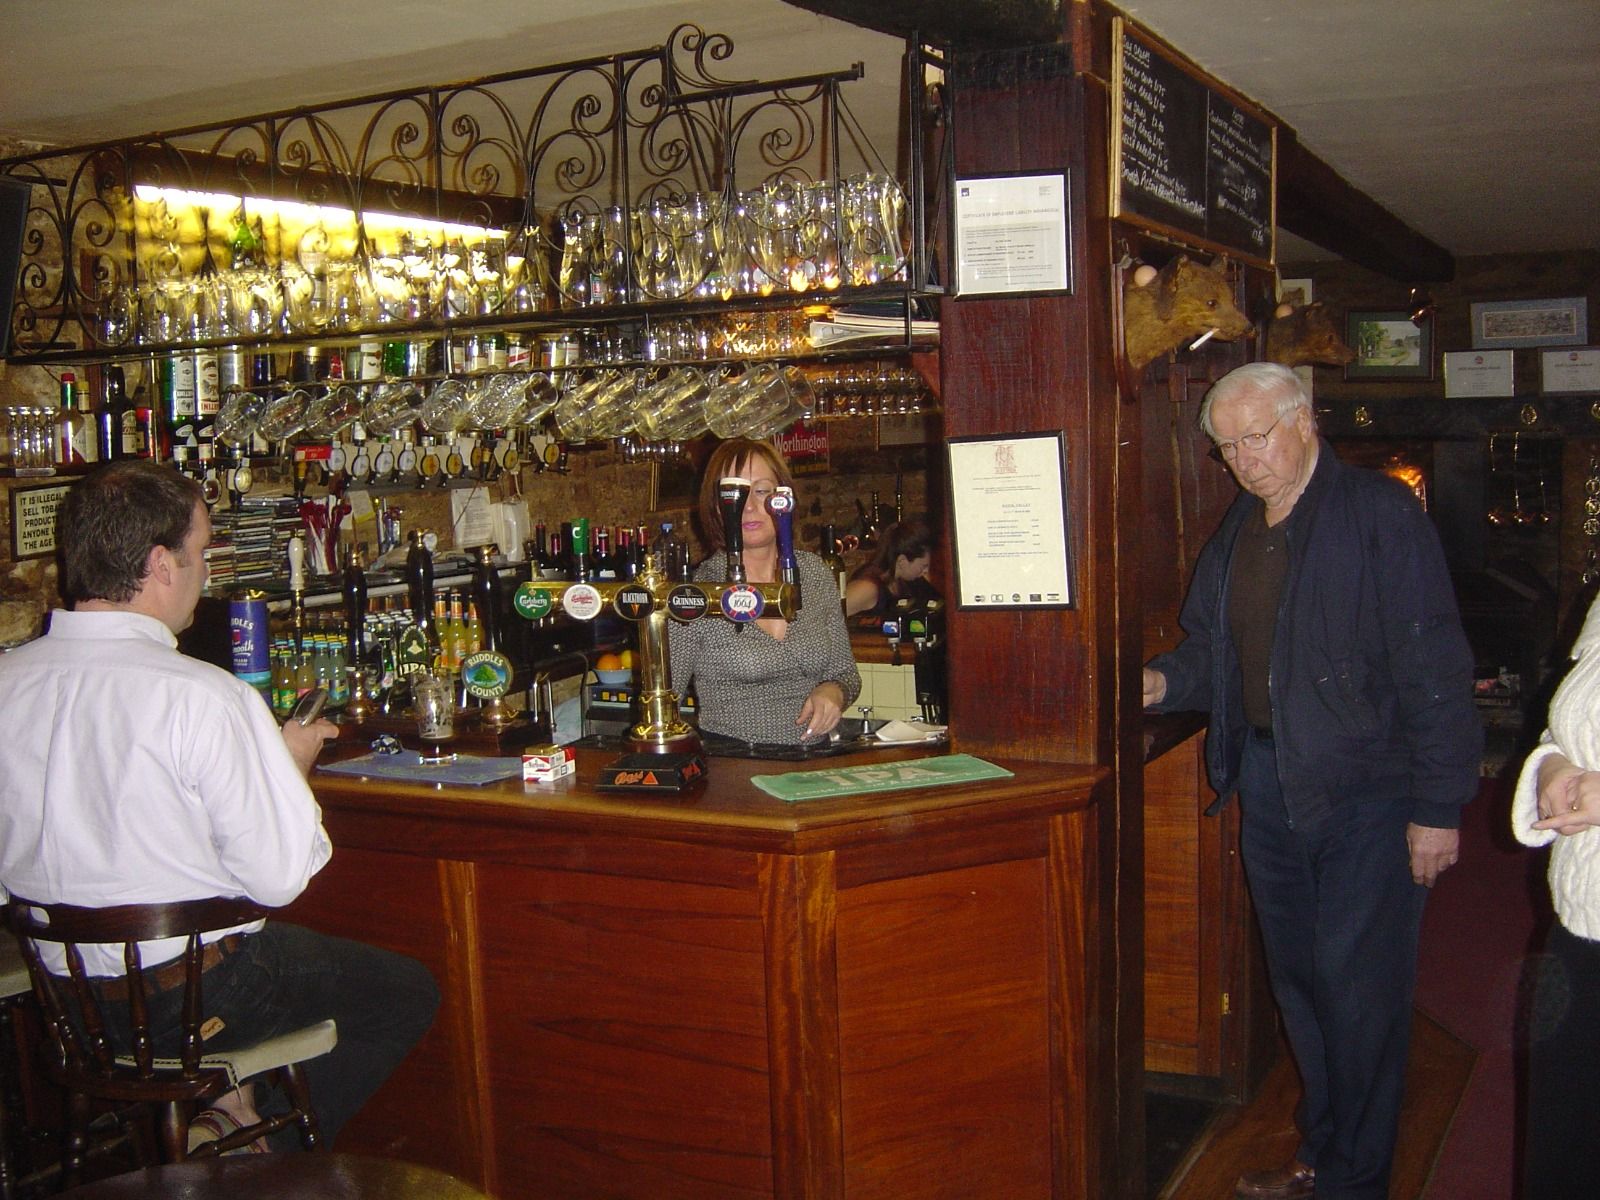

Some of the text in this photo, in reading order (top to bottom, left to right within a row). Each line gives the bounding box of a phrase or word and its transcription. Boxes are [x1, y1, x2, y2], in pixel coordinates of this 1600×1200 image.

[773, 432, 827, 454] Worthington
[20, 497, 26, 506] IT
[29, 496, 35, 505] IS
[23, 507, 39, 517] SELL
[24, 516, 57, 528] PRODUCT
[22, 527, 50, 540] ANYONE
[24, 538, 53, 550] THE AGE
[672, 596, 705, 606] GUINNESS
[467, 653, 504, 667] RUDDLES
[471, 684, 504, 697] COUNTY
[824, 767, 945, 787] IPA
